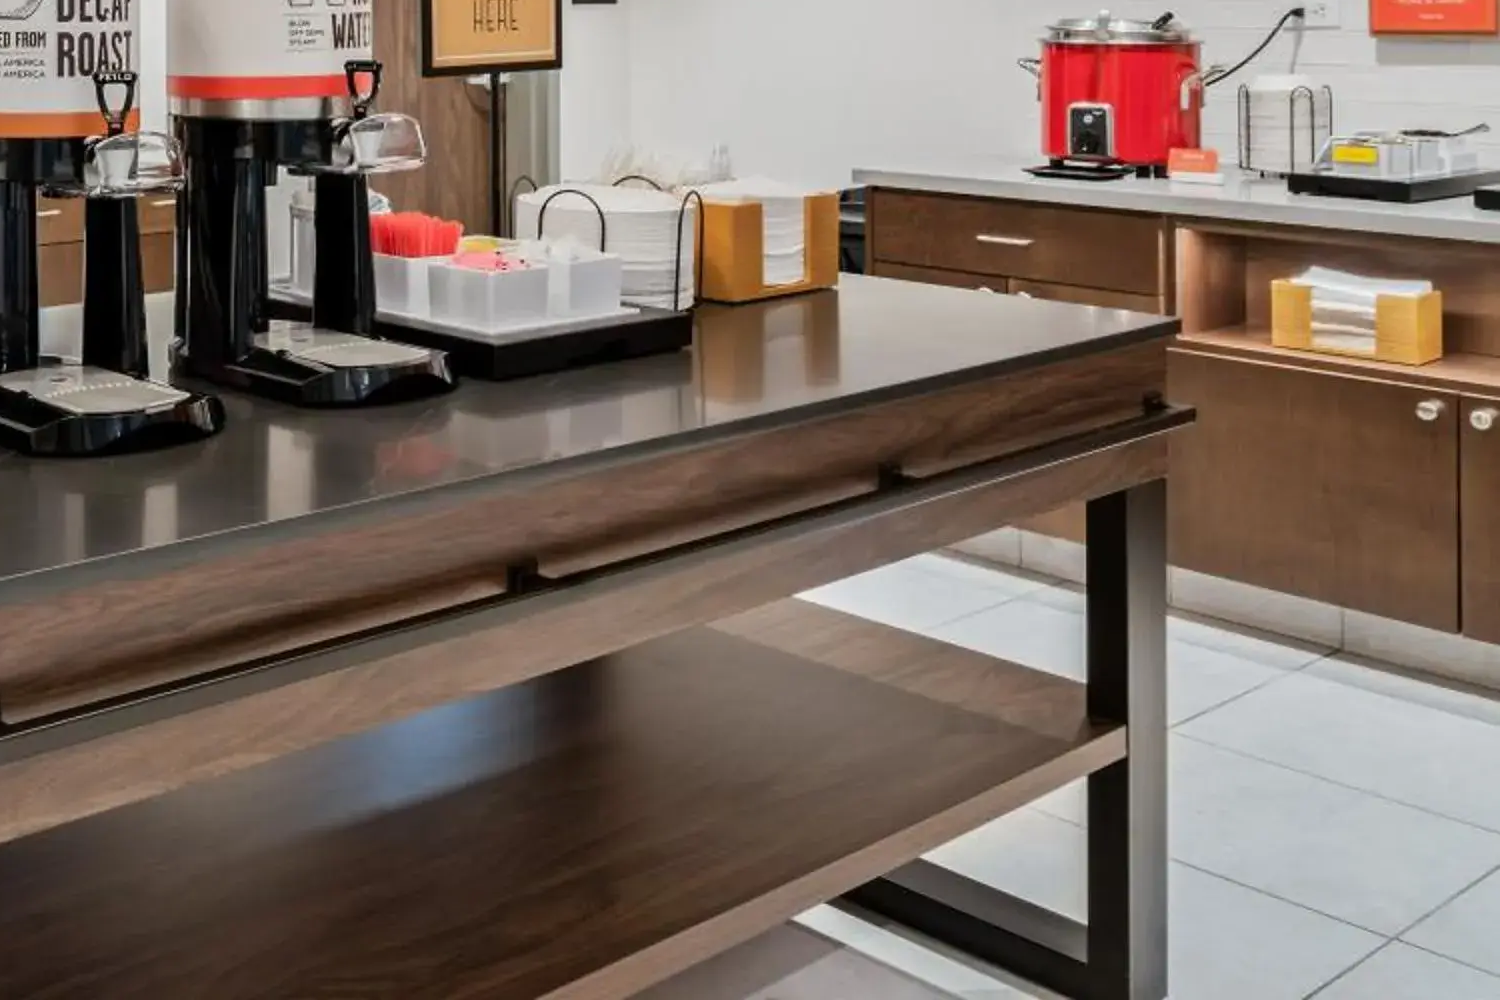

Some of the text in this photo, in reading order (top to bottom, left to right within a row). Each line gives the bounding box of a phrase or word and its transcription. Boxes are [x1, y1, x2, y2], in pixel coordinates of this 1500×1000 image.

[331, 12, 371, 49] WATE
[15, 31, 47, 48] FROM
[3, 58, 45, 67] AMERICA
[56, 31, 133, 78] ROAST
[3, 70, 45, 78] AMERICA
